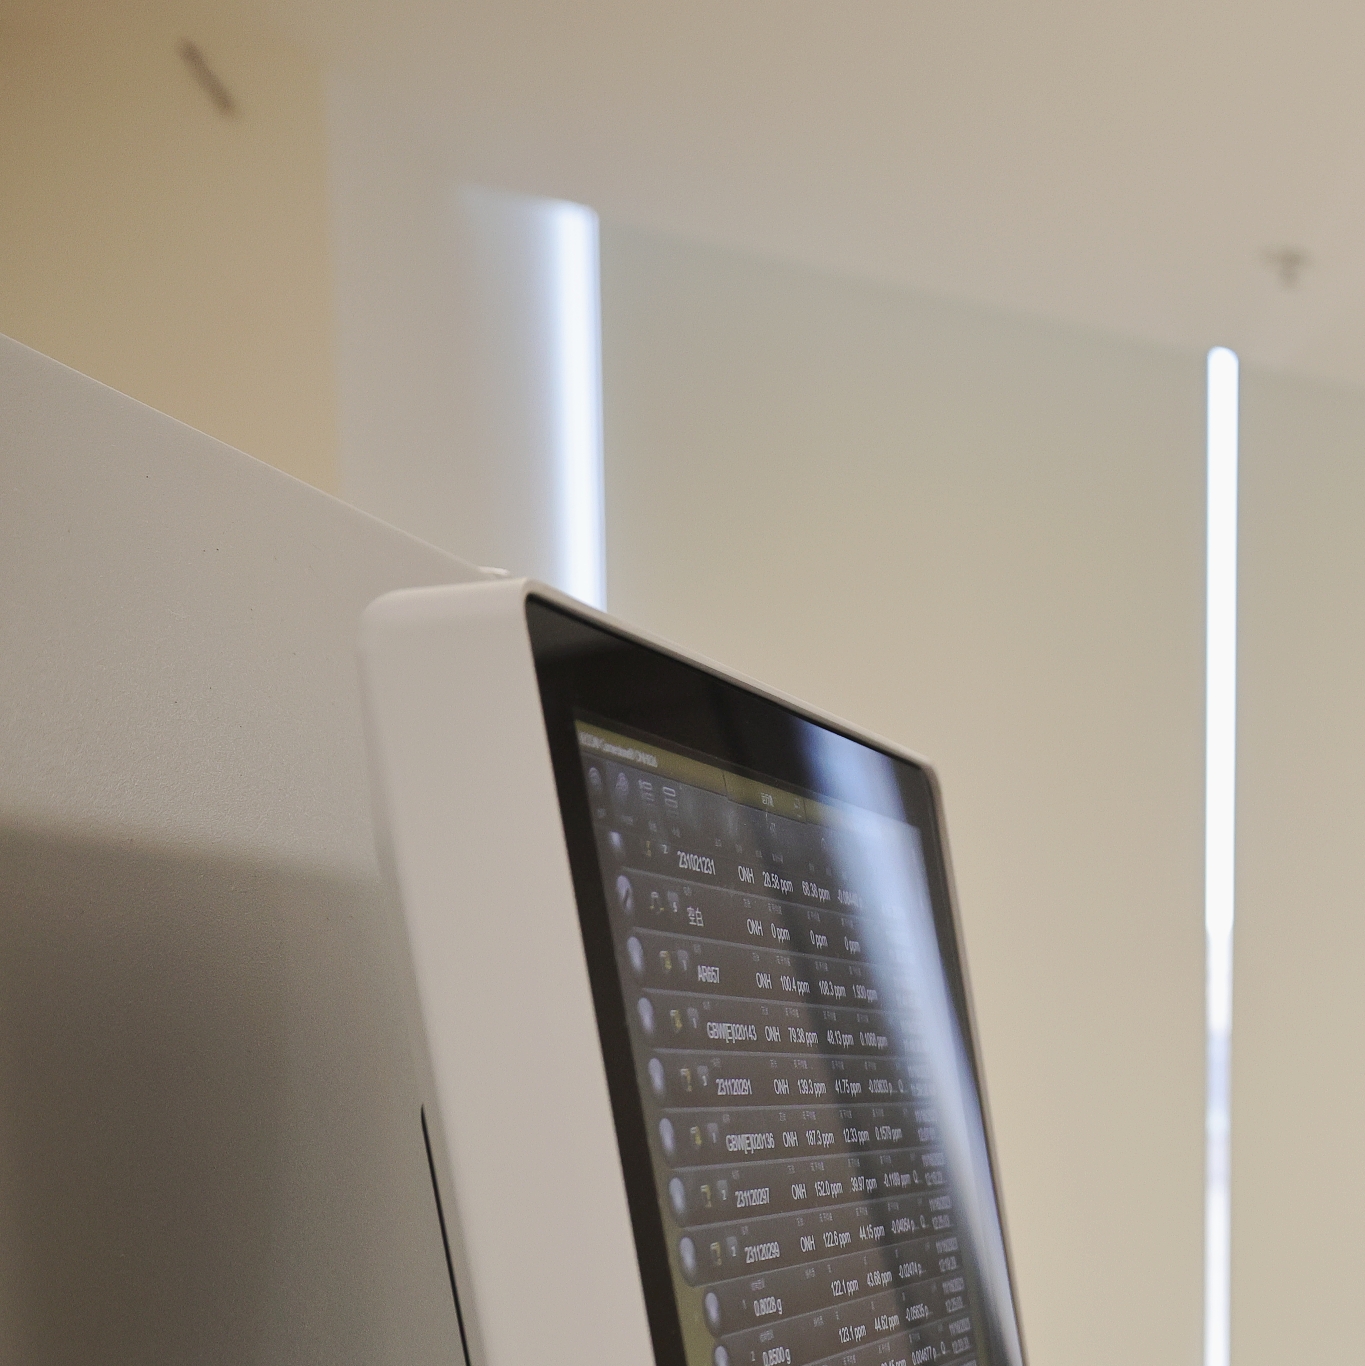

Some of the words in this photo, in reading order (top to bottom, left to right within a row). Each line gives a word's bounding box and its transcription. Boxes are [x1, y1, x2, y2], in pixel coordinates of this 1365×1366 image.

[738, 865, 755, 884] ONH
[780, 878, 795, 895] ppm
[818, 885, 832, 902] ppm
[686, 905, 704, 927] 空白
[746, 918, 763, 937] ONH
[770, 923, 777, 938] 0
[777, 927, 791, 944] ppm
[810, 930, 816, 945] 0
[816, 934, 829, 949] ppm
[849, 940, 861, 955] ppm
[755, 972, 772, 990] ONH
[796, 979, 810, 997] ppm
[834, 985, 847, 1000] ppm
[866, 988, 878, 1003] ppm
[764, 1026, 781, 1043] ONH
[805, 1031, 819, 1047] ppm
[841, 1034, 854, 1049] ppm
[876, 1035, 888, 1050] ppm
[773, 1079, 790, 1095] ONH
[813, 1082, 827, 1098] ppm
[849, 1082, 862, 1097] ppm
[782, 1131, 798, 1148] ONH
[822, 1132, 835, 1149] ppm
[858, 1130, 870, 1145] ppm
[892, 1127, 902, 1142] ppm
[791, 1184, 807, 1200] ONH
[830, 1182, 843, 1198] ppm
[865, 1178, 877, 1193] ppm
[899, 1173, 911, 1188] ppm
[800, 1235, 816, 1253] ONH
[838, 1232, 852, 1250] ppm
[873, 1225, 886, 1241] ppm
[777, 1299, 783, 1315] g
[846, 1279, 859, 1297] ppm
[881, 1271, 893, 1287] ppm
[785, 1348, 791, 1365] g
[854, 1325, 867, 1343] ppm
[888, 1314, 900, 1331] ppm
